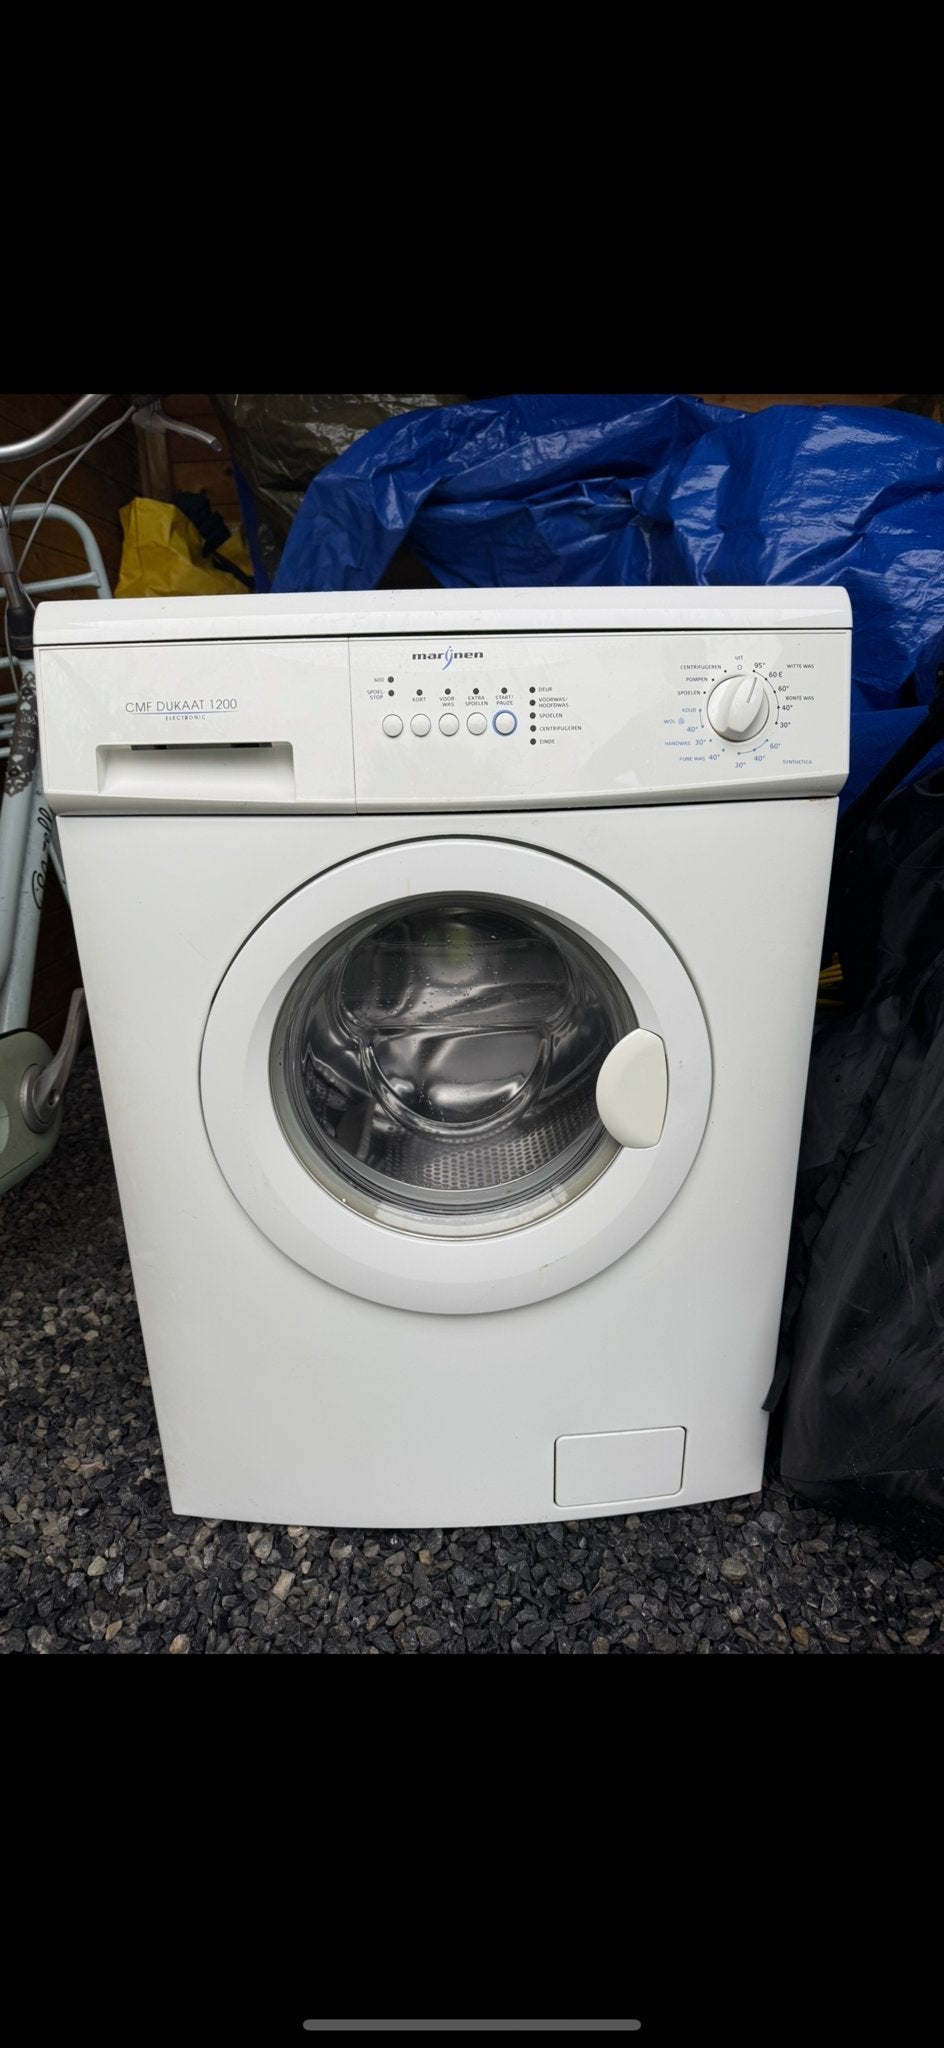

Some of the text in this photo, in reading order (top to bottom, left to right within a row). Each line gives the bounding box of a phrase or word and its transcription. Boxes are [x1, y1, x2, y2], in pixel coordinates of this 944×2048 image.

[125, 698, 238, 713] CMF DUKAAT 1200
